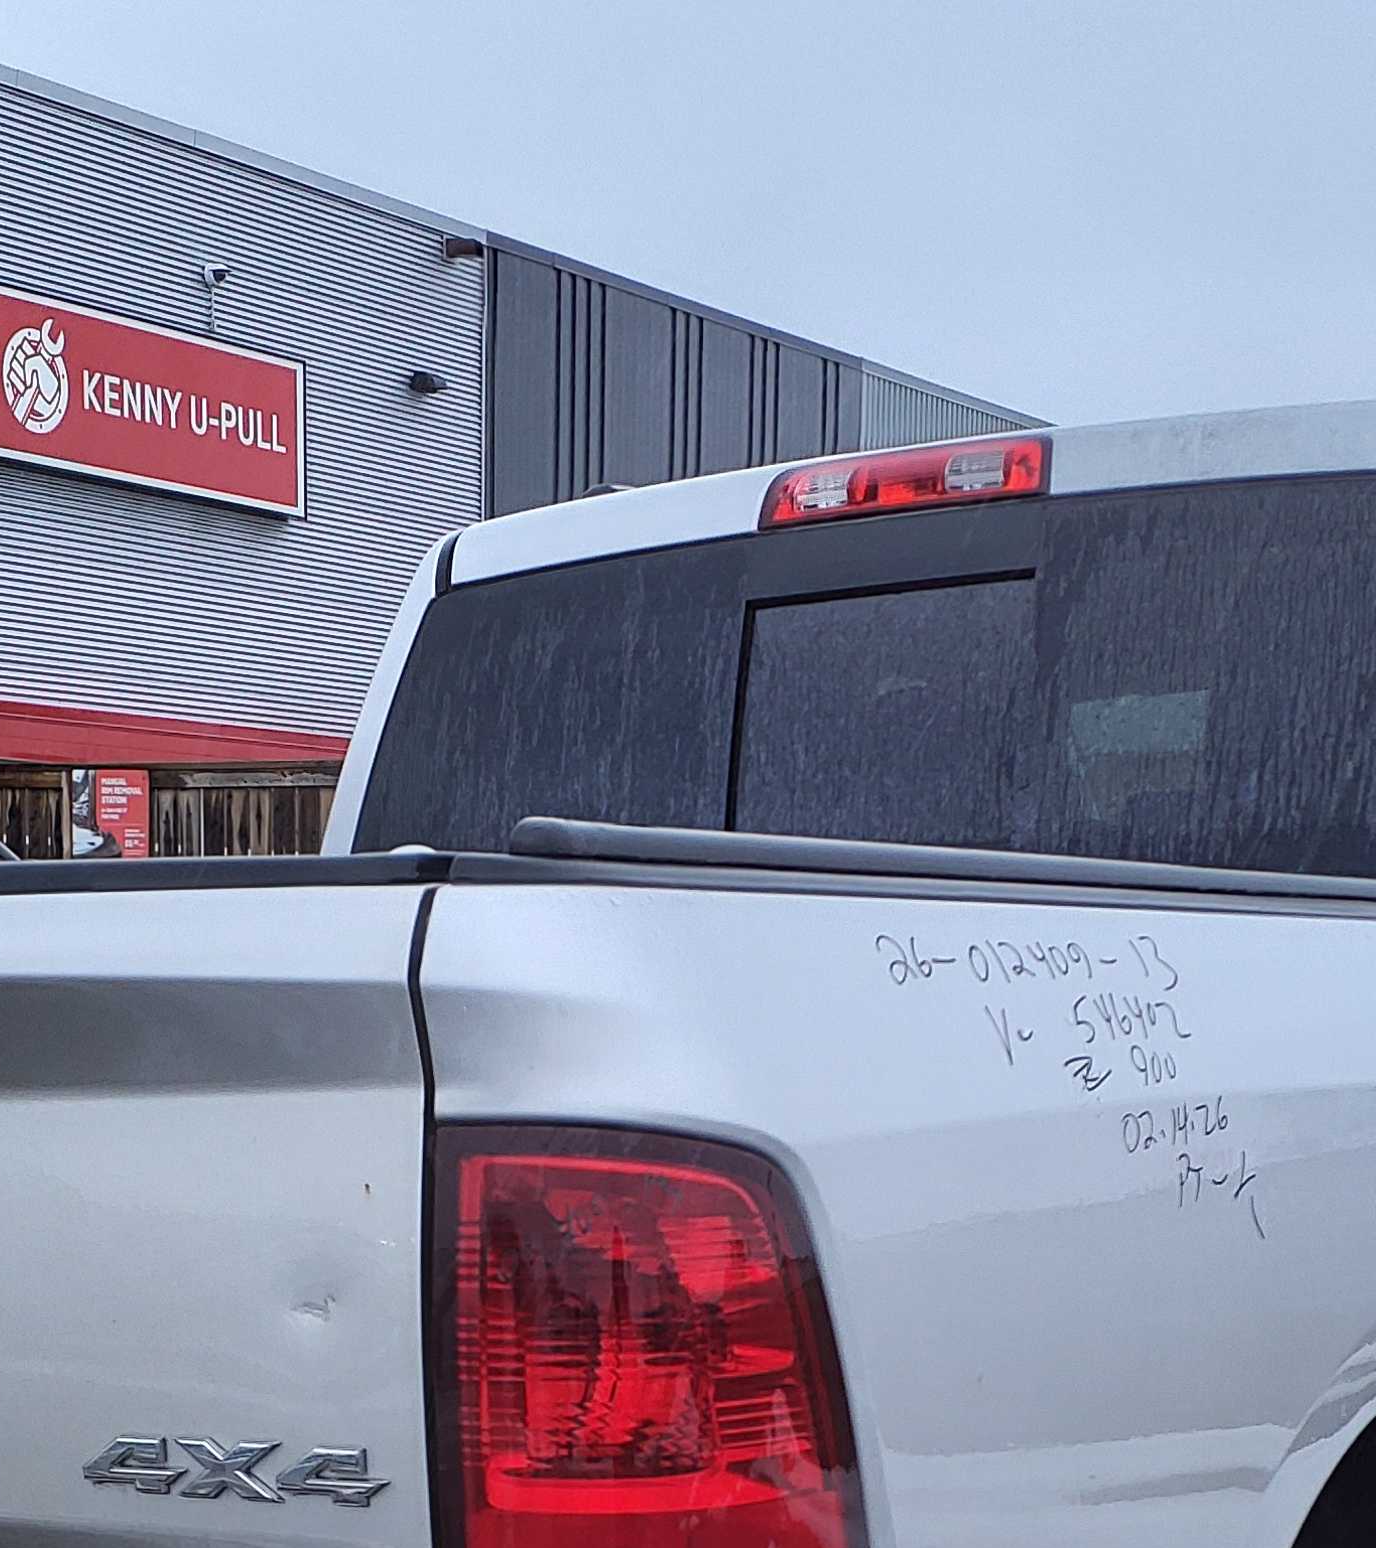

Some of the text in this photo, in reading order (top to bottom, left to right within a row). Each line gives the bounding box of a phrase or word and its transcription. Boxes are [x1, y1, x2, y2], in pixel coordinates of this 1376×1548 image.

[82, 369, 287, 455] KENNY U-PULL
[1129, 1043, 1177, 1086] 900
[82, 1436, 392, 1508] 4X4
